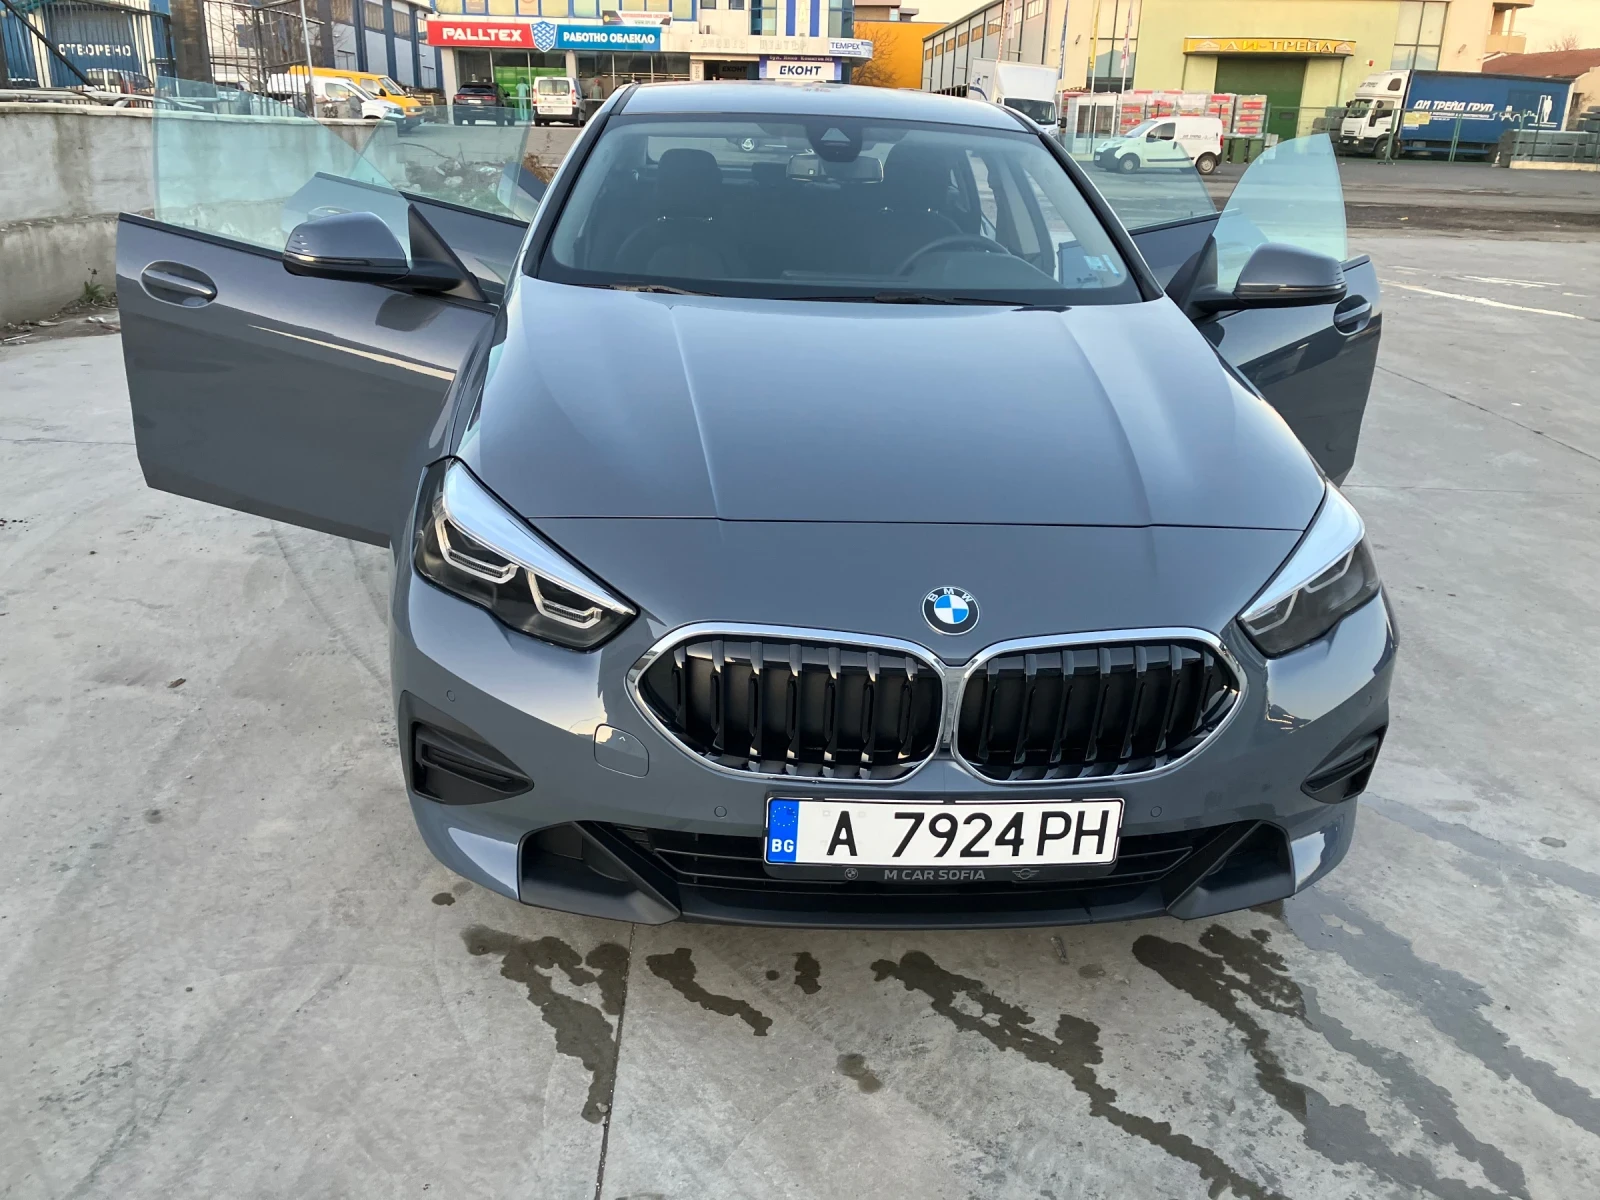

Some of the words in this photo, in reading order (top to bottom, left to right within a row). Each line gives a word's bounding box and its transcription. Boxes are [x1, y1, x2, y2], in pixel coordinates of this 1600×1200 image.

[442, 27, 522, 42] PALLTEX
[563, 31, 608, 43] РАБОТНО
[609, 33, 655, 44] ОБЛЕКЛО
[830, 41, 860, 50] TEMPEX
[779, 65, 822, 76] ЕКОНТ
[1414, 99, 1431, 110] ДИ
[1432, 100, 1466, 111] ТРЕЙД
[1467, 102, 1494, 112] ГРУП
[927, 588, 973, 602] BMW
[827, 811, 857, 856] A
[772, 839, 794, 853] BG
[884, 869, 898, 880] M
[901, 869, 935, 880] CAR
[938, 869, 986, 880] SOFIA
